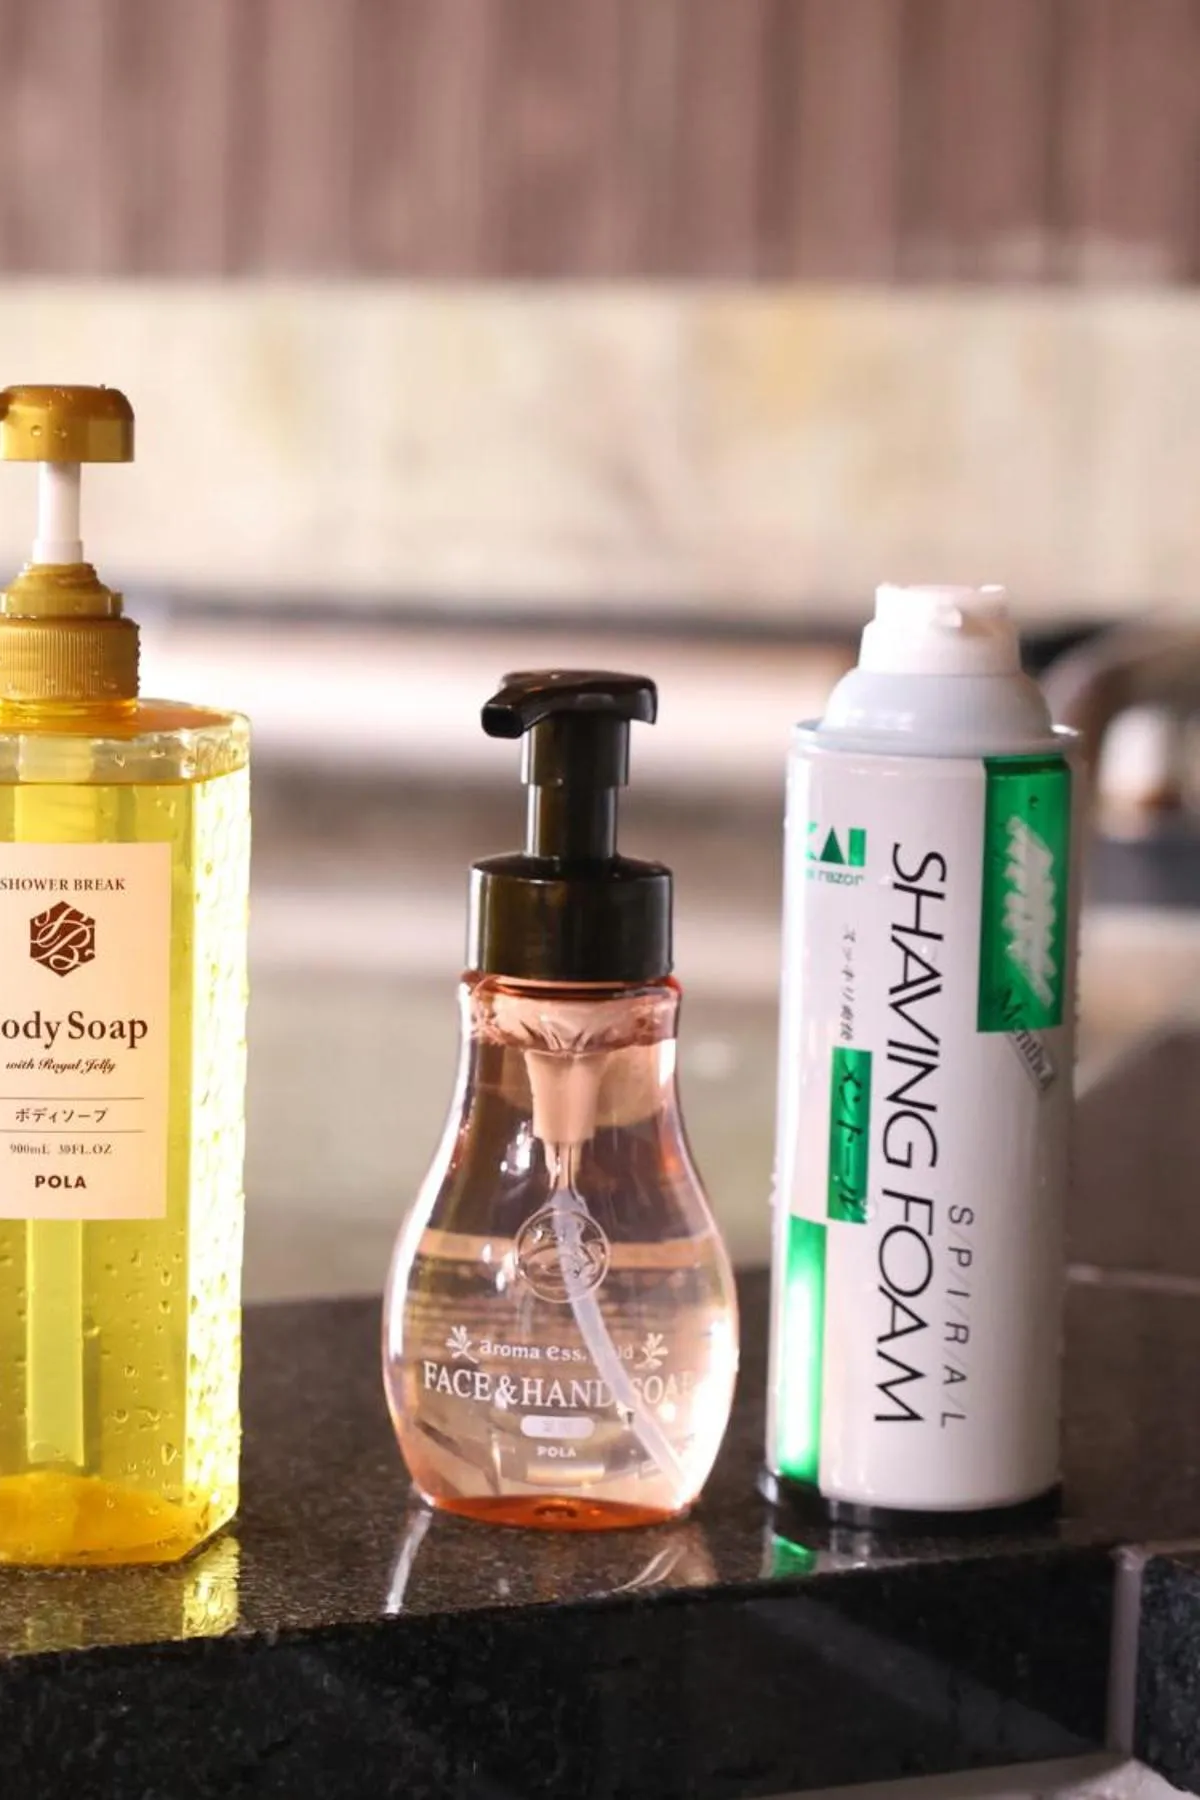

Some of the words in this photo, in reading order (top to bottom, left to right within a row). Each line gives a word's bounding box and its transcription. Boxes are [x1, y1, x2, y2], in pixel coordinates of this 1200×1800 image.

[0, 878, 69, 891] SHOWER
[73, 878, 126, 891] BREAK
[883, 842, 947, 1168] SHAVING
[67, 1010, 148, 1049] Soap
[5, 1058, 35, 1070] with
[38, 1058, 82, 1074] Royal
[80, 1058, 116, 1074] Jelly
[15, 1107, 109, 1123] ボディソープ
[836, 1058, 865, 1214] メントール
[34, 1175, 87, 1189] POLA
[874, 1188, 933, 1421] FOAM
[479, 1339, 541, 1359] aroma
[537, 1445, 576, 1458] POLA
